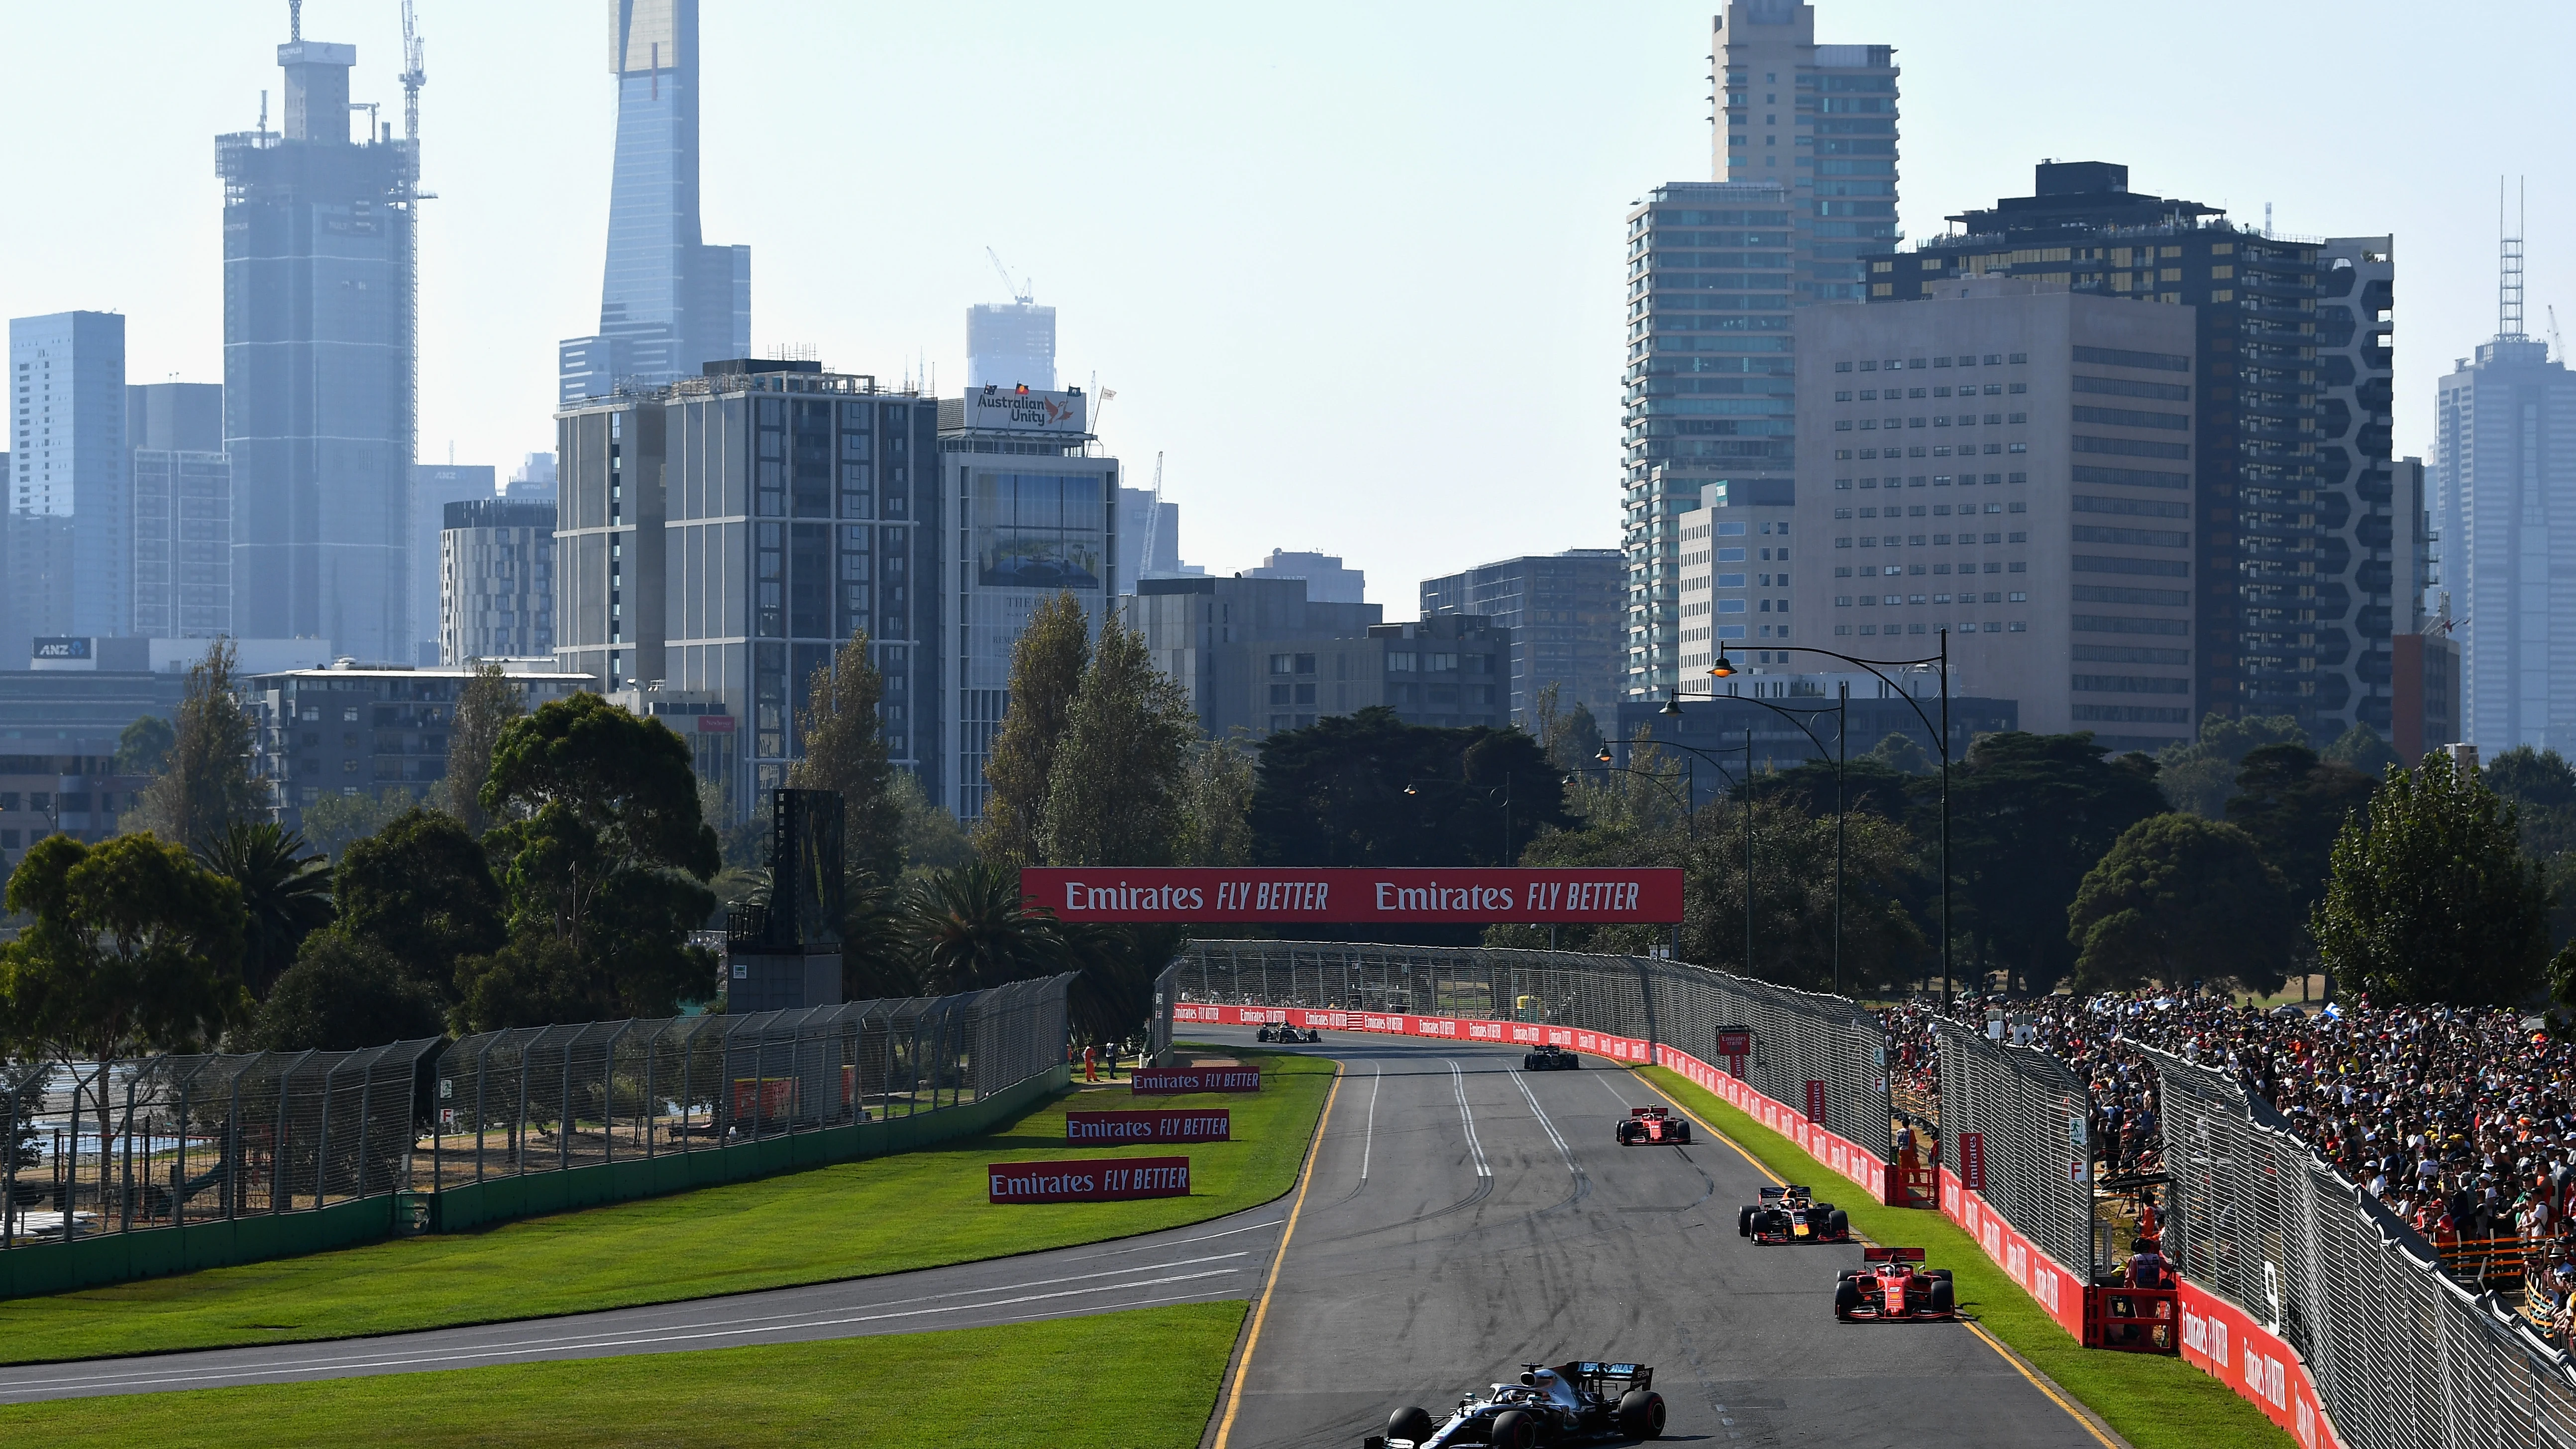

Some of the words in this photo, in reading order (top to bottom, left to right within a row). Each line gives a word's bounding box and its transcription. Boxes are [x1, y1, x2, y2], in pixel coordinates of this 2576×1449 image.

[977, 395, 1044, 410] Australian
[1012, 409, 1045, 426] Unity
[40, 644, 69, 655] ANZ
[1065, 881, 1203, 910] Emirates
[1216, 882, 1251, 910] FLY
[1256, 882, 1329, 910] BETTER
[1375, 881, 1513, 910] Emirates
[1527, 883, 1561, 910] FLY
[1567, 883, 1639, 910] BETTER
[1174, 1007, 1196, 1020] mirates
[1240, 1009, 1265, 1023] Emirates
[1305, 1012, 1328, 1026] Emirates
[1365, 1015, 1385, 1029] Emirates
[1133, 1074, 1199, 1089] Emirates
[1205, 1073, 1221, 1088] FLY
[1224, 1073, 1259, 1087] BETTER
[1874, 1078, 1882, 1091] F
[443, 1110, 451, 1122] F
[1068, 1119, 1152, 1138] Emirates
[1160, 1118, 1180, 1136] FLY
[1183, 1118, 1227, 1136] BETTER
[1968, 1136, 1978, 1187] Emirates
[2071, 1162, 2082, 1180] F
[991, 1172, 1094, 1195] Emirates
[1104, 1169, 1129, 1191] FLY
[1133, 1167, 1187, 1190] BETTER
[2264, 1260, 2280, 1336] 9
[2182, 1301, 2208, 1355] Emirates
[2244, 1337, 2264, 1397] Emirates
